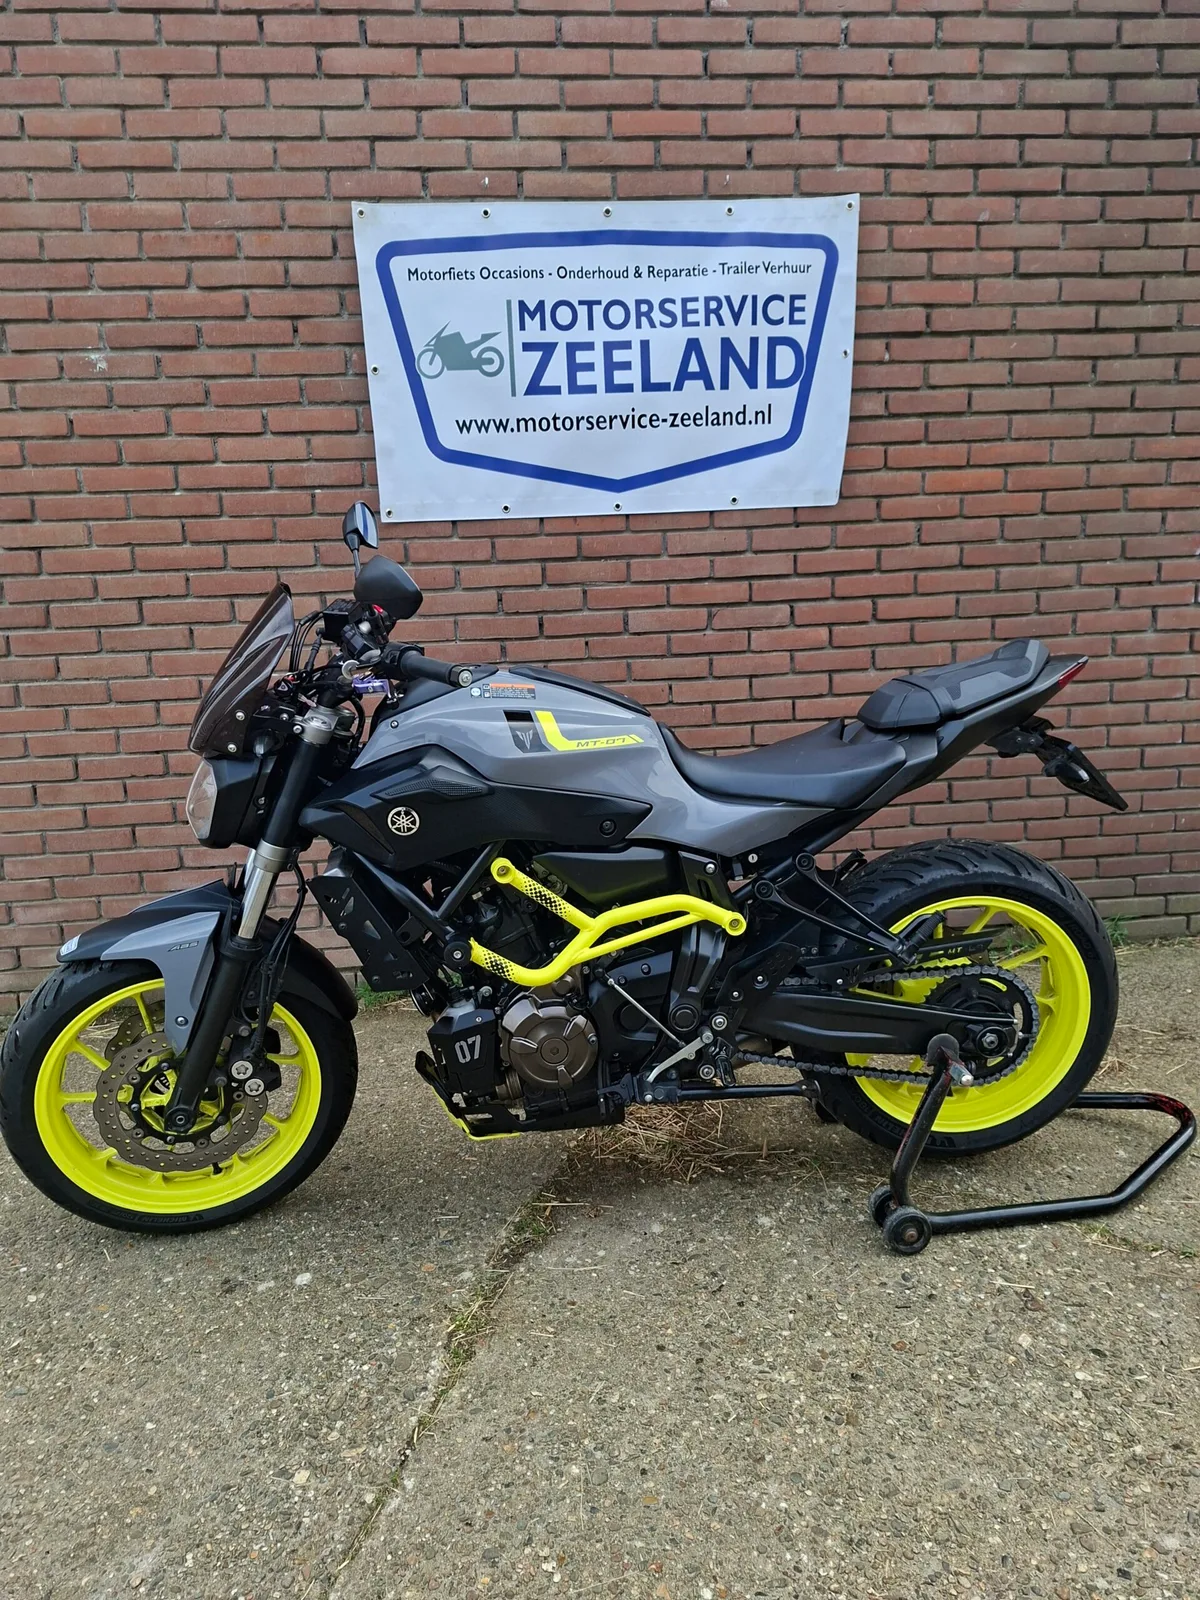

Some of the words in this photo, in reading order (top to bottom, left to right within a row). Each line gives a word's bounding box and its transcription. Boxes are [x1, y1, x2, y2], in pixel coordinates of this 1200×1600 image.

[407, 266, 476, 282] Motorfiets
[479, 265, 545, 280] Occasions
[556, 265, 629, 280] Onderhoud
[633, 265, 643, 279] &
[647, 264, 709, 282] Reparatie
[718, 262, 761, 276] Trailer
[762, 260, 812, 274] Verhuur
[518, 293, 807, 332] MOTORSERVICE
[523, 336, 805, 397] ZEELAND
[455, 404, 772, 435] www.motorservice-zeeland.nl
[576, 737, 626, 748] MT-07
[454, 1034, 481, 1064] 07
